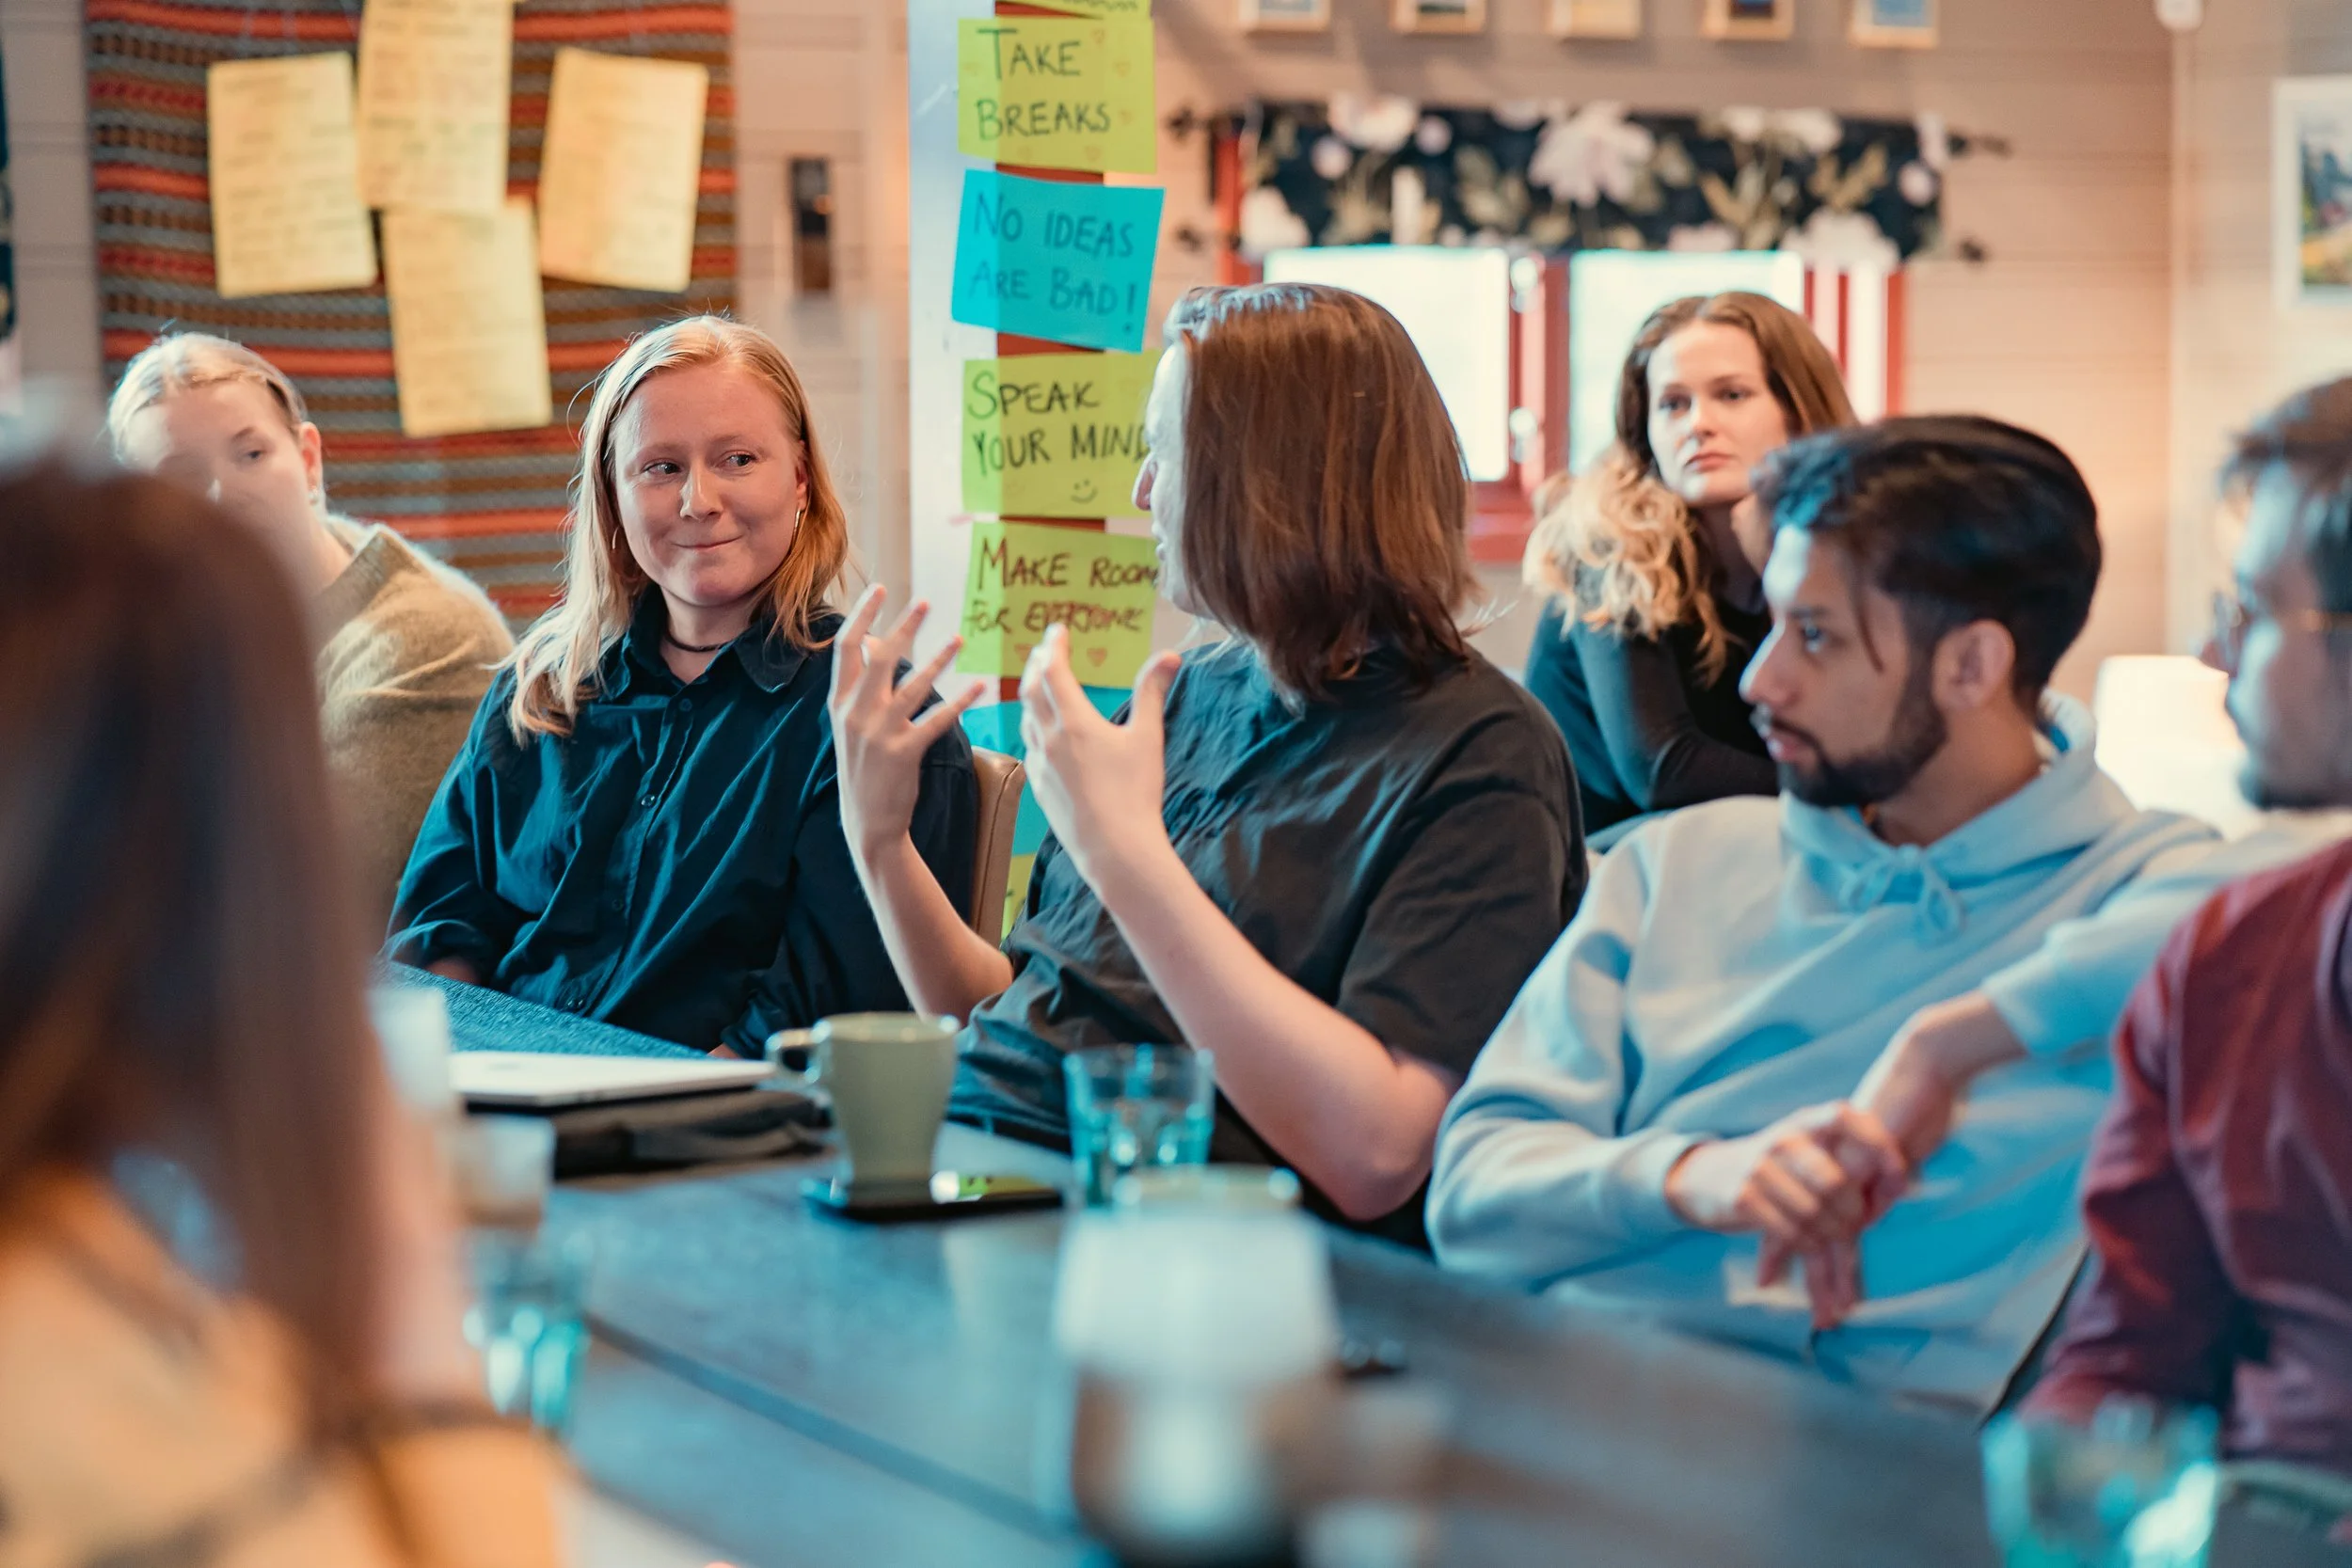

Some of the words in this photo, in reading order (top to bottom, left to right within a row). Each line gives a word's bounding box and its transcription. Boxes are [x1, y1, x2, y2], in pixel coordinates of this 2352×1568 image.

[976, 27, 1082, 80] TAKE
[976, 99, 1111, 141] BREAKS
[973, 191, 1025, 243] NO
[1043, 208, 1135, 260] IDEAS
[968, 260, 1031, 301] ARE
[1049, 266, 1137, 333] BAD!
[967, 370, 1101, 420] SPEAK
[973, 427, 1051, 476] YOUR
[977, 536, 1071, 592] MAKE
